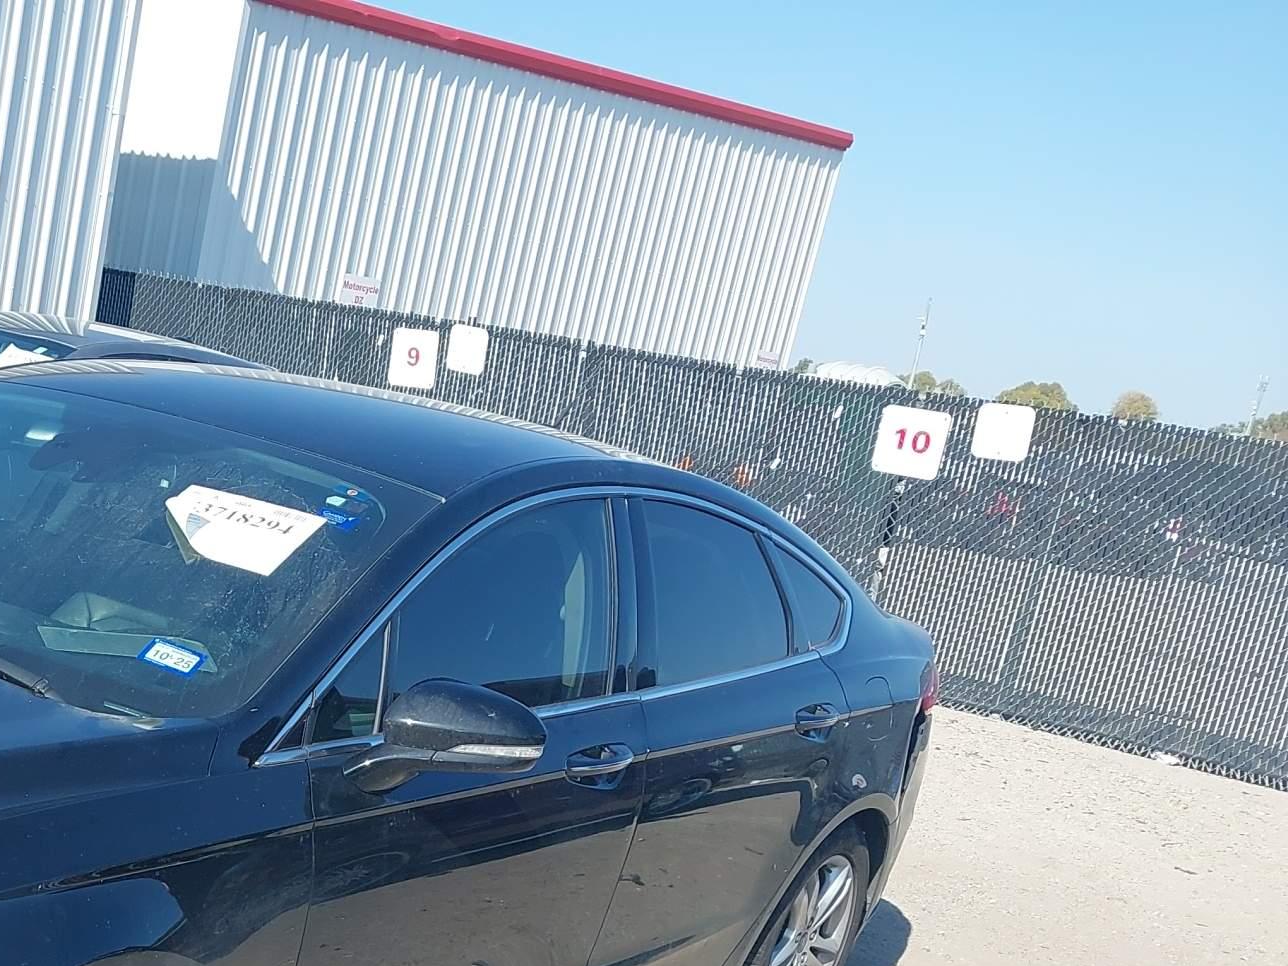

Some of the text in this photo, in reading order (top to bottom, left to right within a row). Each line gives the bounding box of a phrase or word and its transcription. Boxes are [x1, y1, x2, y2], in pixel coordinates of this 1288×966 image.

[343, 279, 379, 295] Motorcycle
[406, 346, 420, 367] 9
[895, 427, 931, 454] 10
